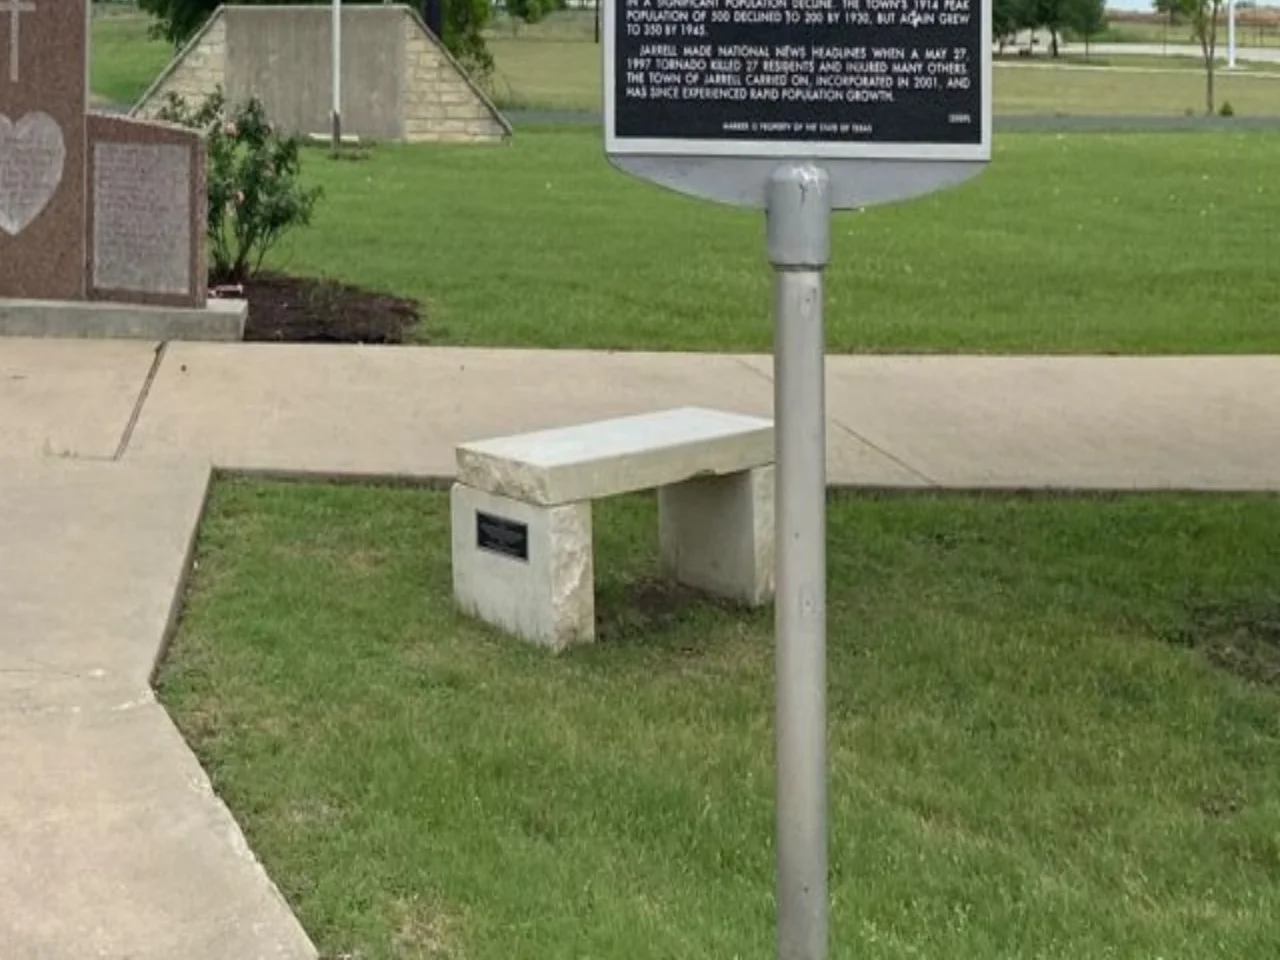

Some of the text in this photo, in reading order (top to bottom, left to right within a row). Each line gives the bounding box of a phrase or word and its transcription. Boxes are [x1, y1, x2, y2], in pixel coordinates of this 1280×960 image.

[639, 44, 677, 56] JARRELL
[683, 45, 711, 56] MADE
[717, 45, 769, 57] NATIONAL
[775, 46, 806, 57] NEWS
[811, 46, 866, 58] HEADLINES
[871, 47, 904, 58] WHEN
[910, 47, 919, 58] A
[924, 47, 947, 59] MAY
[626, 72, 644, 84] THE
[648, 72, 681, 84] TOWN
[685, 73, 698, 84] OF
[704, 73, 741, 85] JARRELL
[745, 74, 787, 85] CARRIED
[815, 74, 893, 87] INCORPORATED
[897, 75, 909, 87] IN
[946, 76, 970, 88] AND
[626, 86, 647, 97] HAS
[649, 87, 678, 98] SINCE
[682, 87, 747, 99] EXPERIENCED
[749, 88, 779, 99] RAPID
[781, 88, 843, 100] POPULATION
